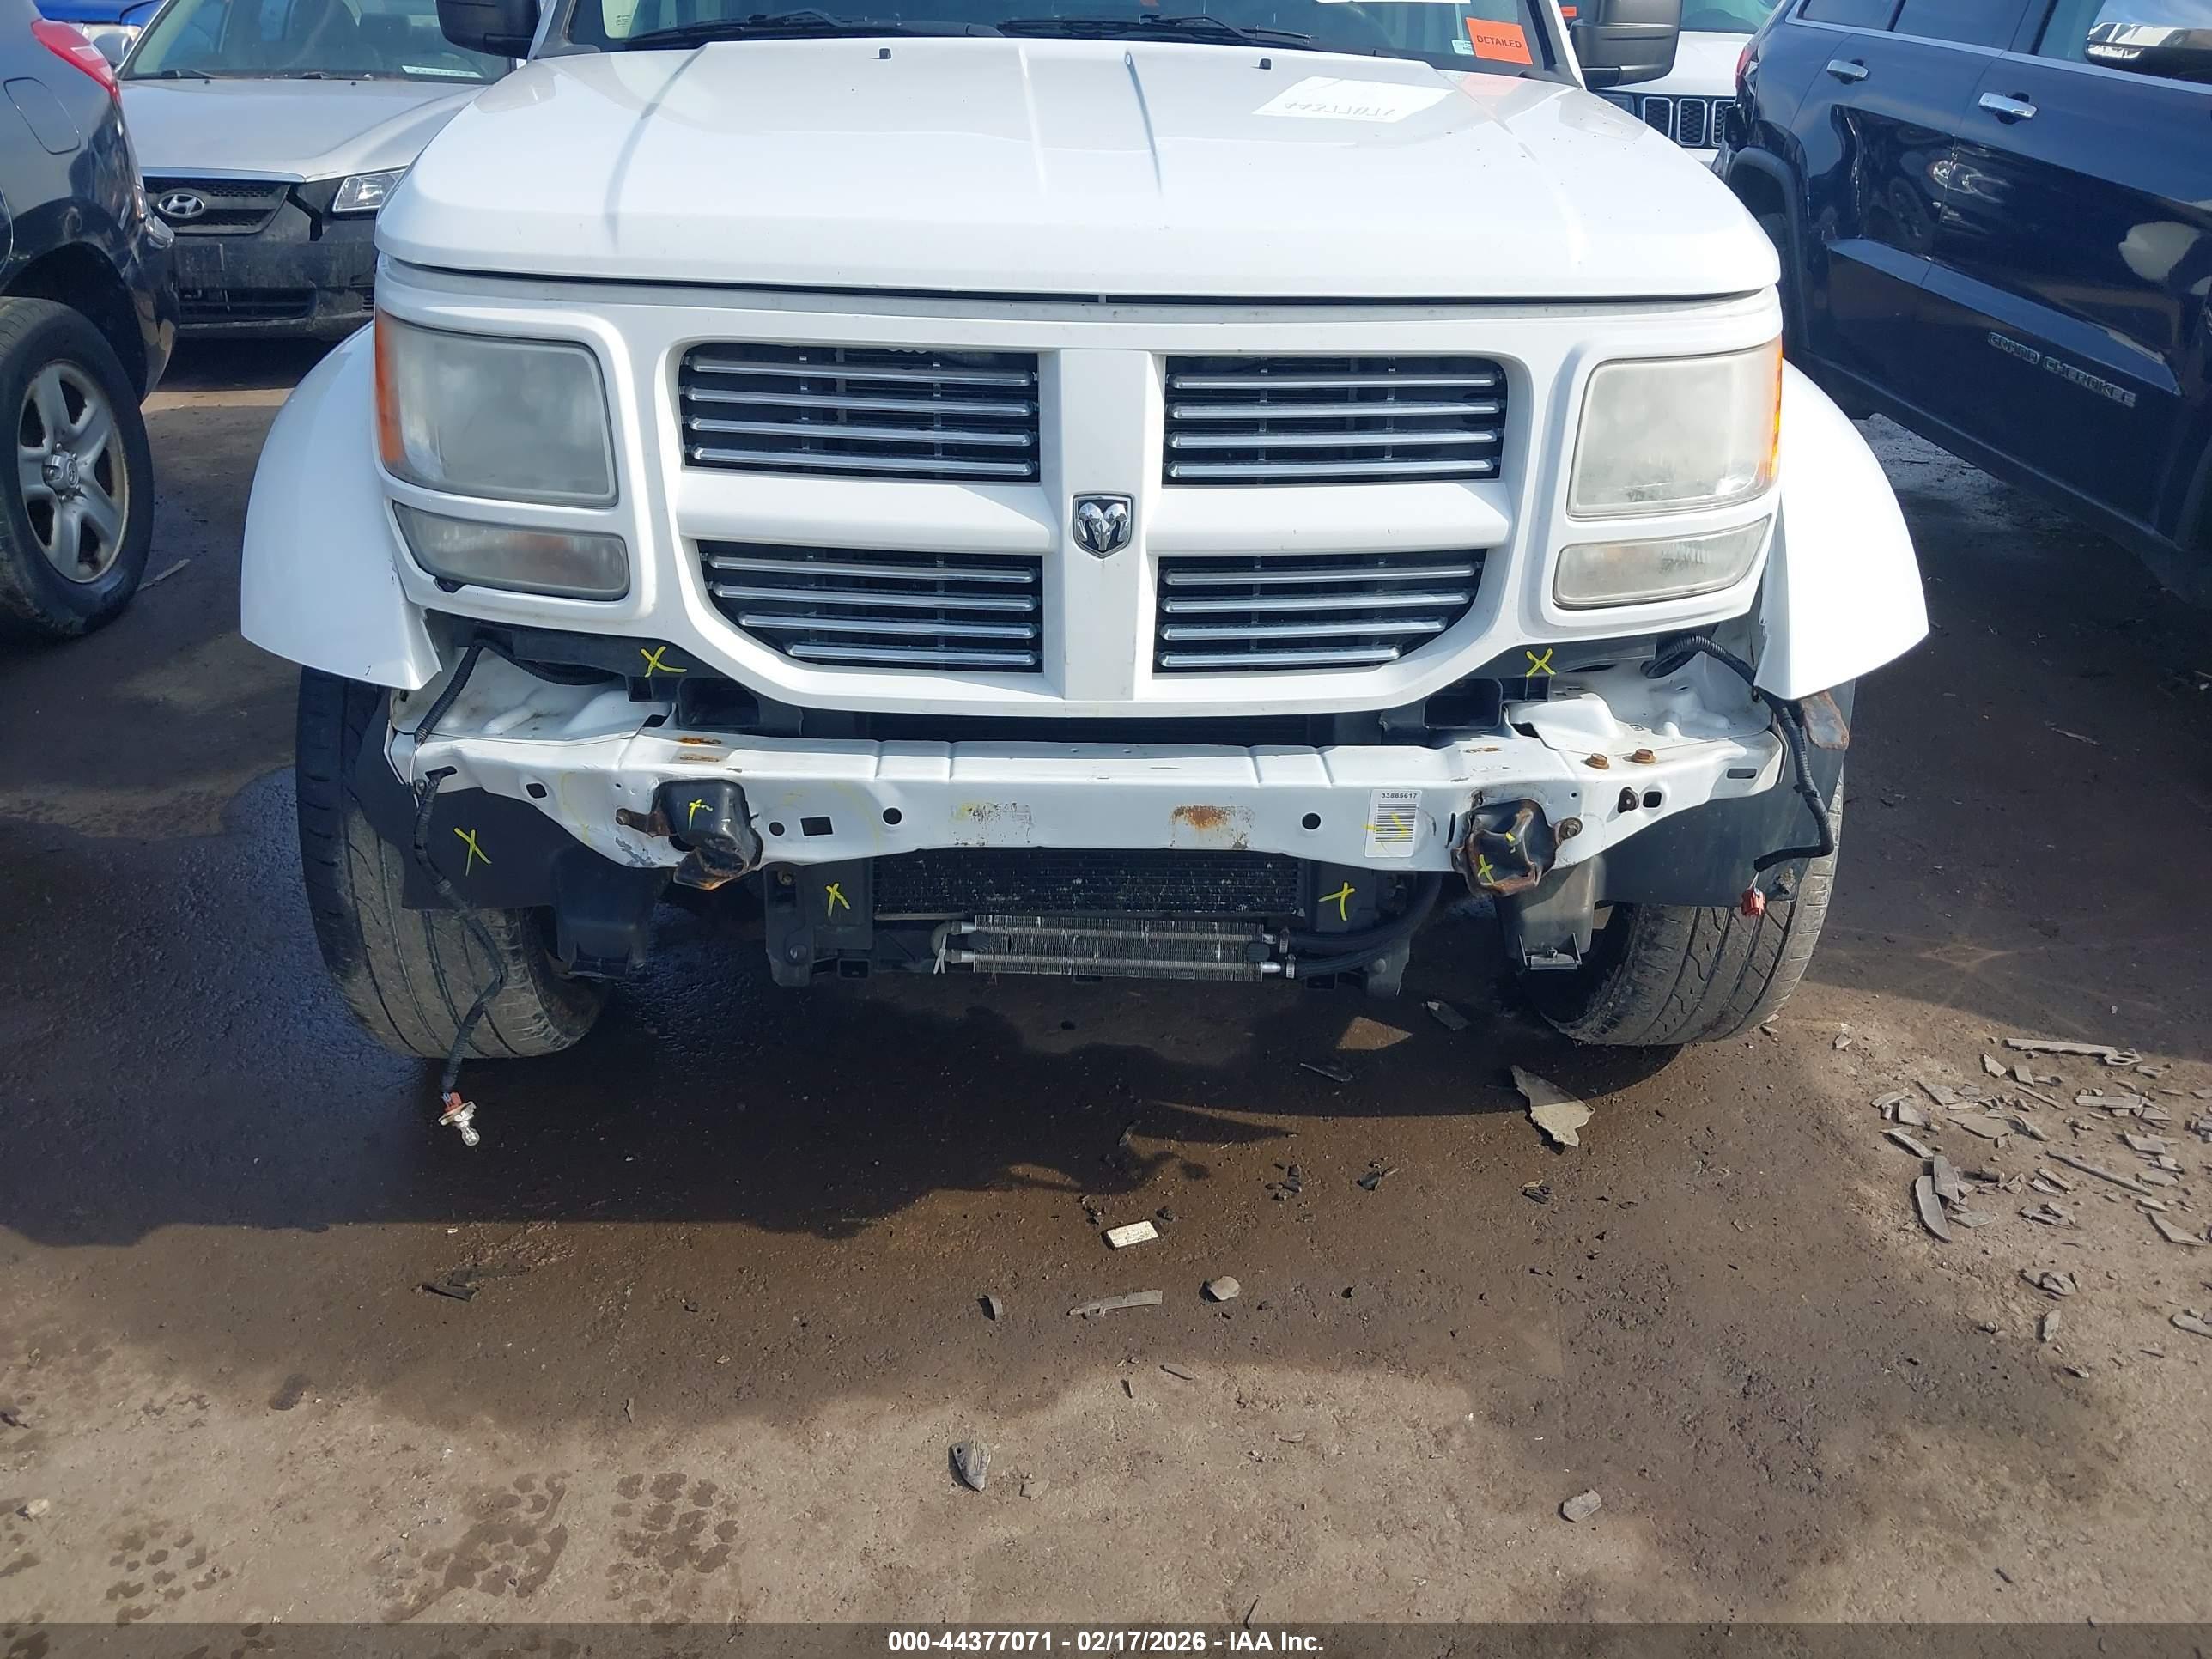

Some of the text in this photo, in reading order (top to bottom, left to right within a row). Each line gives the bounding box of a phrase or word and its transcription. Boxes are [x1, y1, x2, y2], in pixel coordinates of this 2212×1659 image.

[1476, 34, 1522, 49] DETAILED
[1987, 331, 2137, 408] GRAND CHEROKEE
